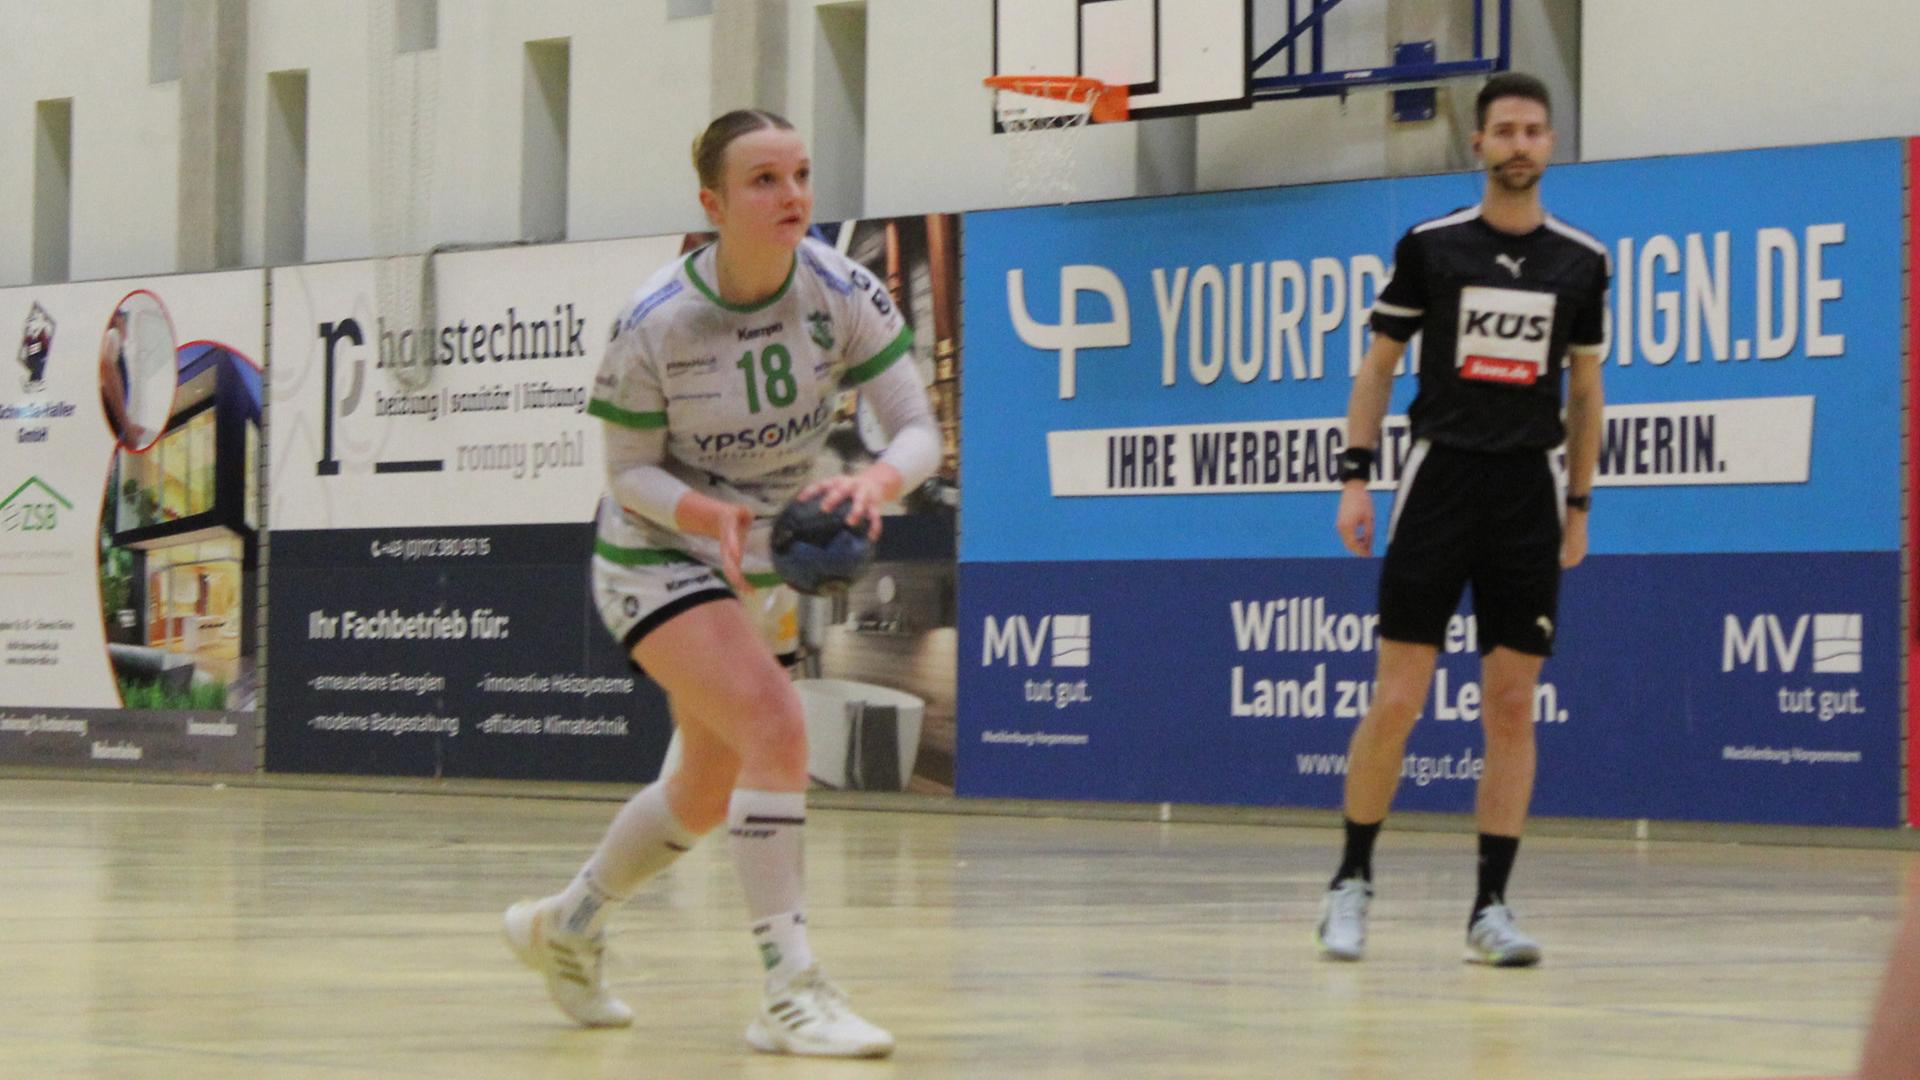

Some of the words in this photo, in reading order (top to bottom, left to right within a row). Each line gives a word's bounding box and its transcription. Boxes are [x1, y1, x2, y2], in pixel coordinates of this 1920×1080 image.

[736, 342, 798, 415] 18
[694, 402, 830, 452] YPSOM
[1107, 434, 1176, 489] IHRE
[1190, 425, 1414, 487] WERBEAGT
[1598, 413, 1727, 476] WERIN.
[456, 443, 527, 480] ronny
[531, 430, 586, 480] pohl
[308, 610, 339, 639] Ihr
[341, 610, 468, 640] Fachbetrieb
[470, 609, 510, 640] für:
[982, 614, 1051, 667] MV
[1231, 597, 1479, 653] Willkoe
[1722, 614, 1811, 673] MV
[1231, 664, 1327, 718] Land
[1434, 668, 1569, 723] Len.
[1778, 687, 1815, 714] tut
[1817, 688, 1866, 722] gut.
